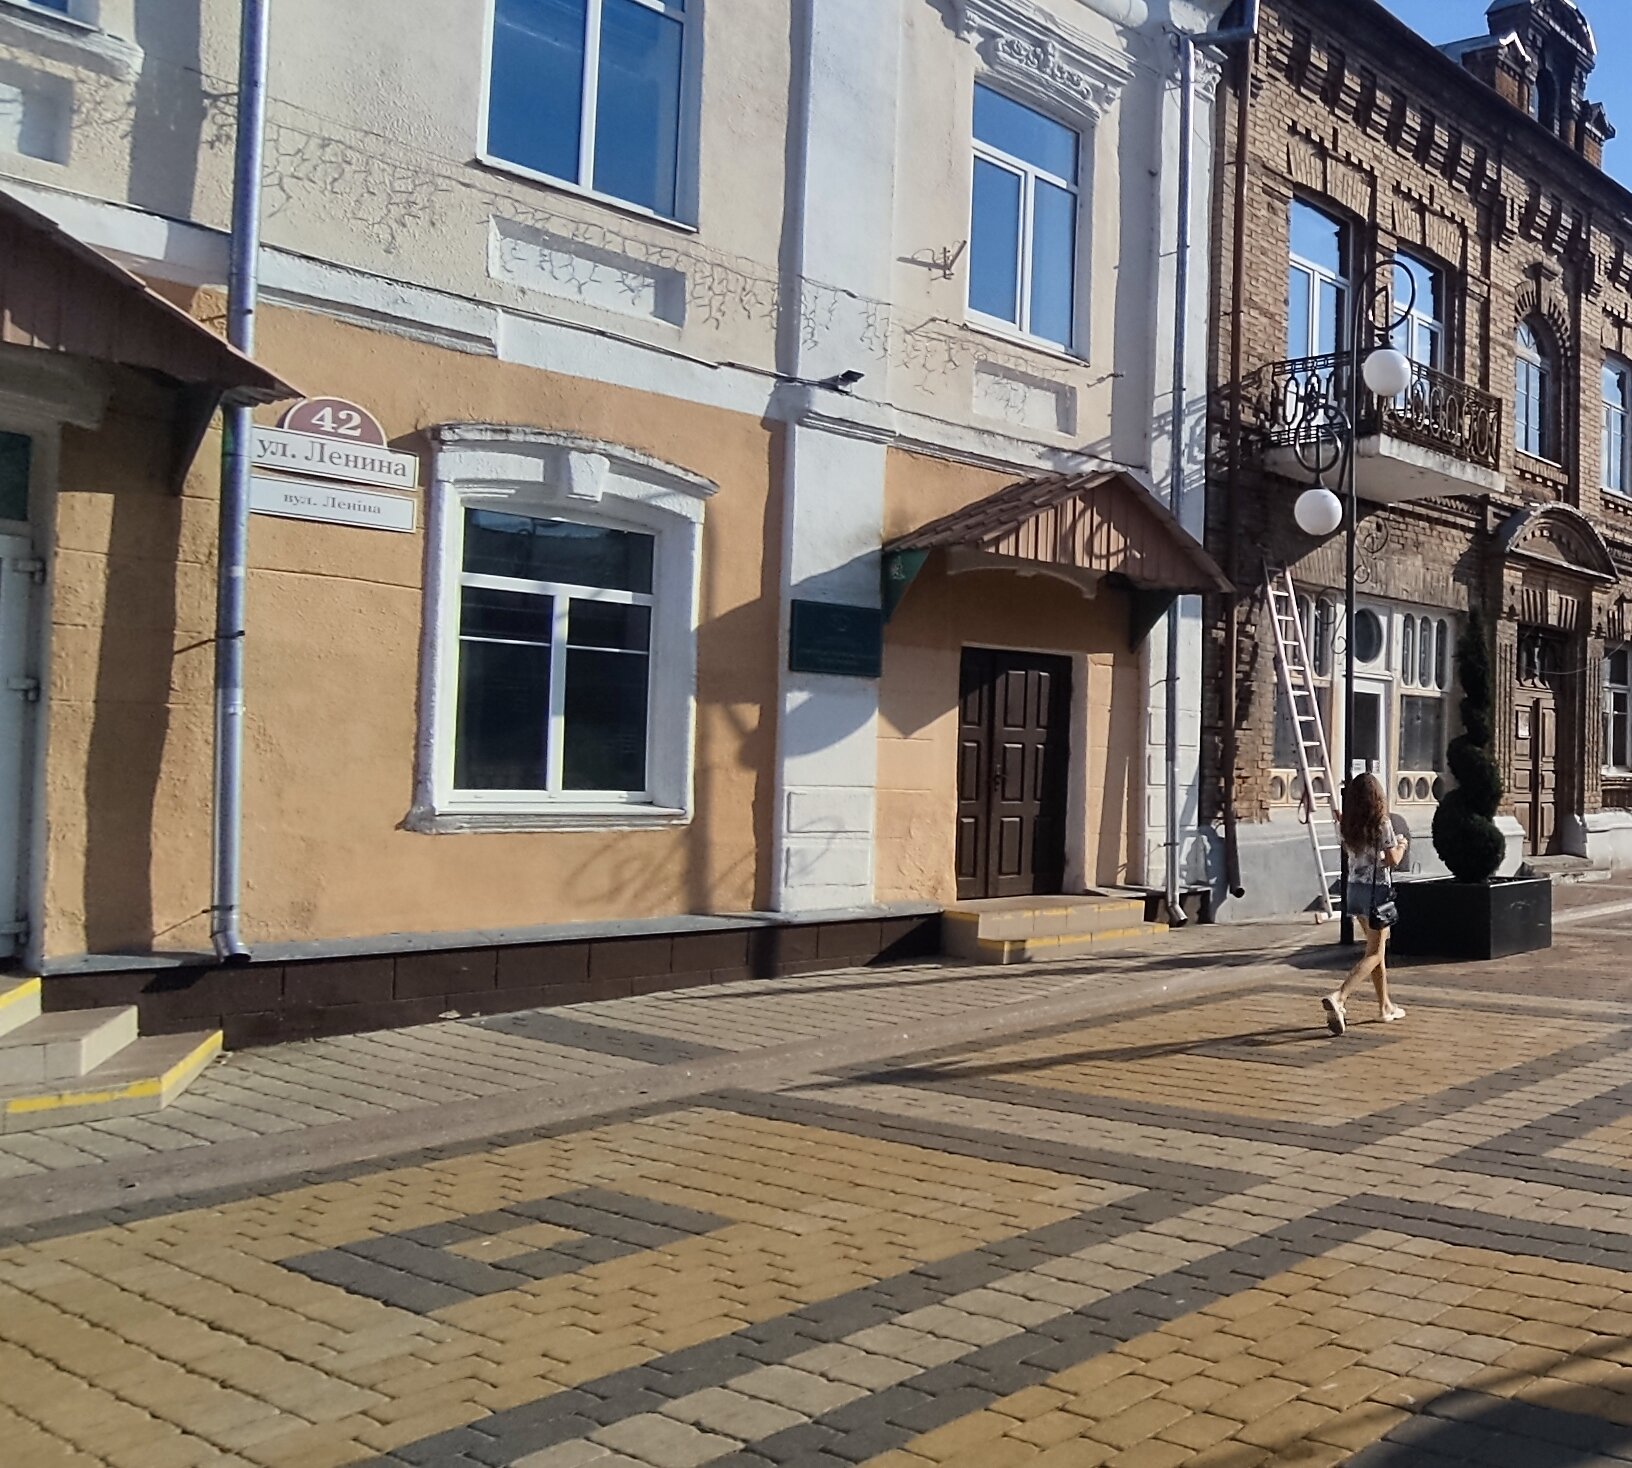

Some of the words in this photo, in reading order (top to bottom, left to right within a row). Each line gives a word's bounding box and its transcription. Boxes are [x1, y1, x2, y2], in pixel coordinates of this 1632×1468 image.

[311, 406, 362, 437] 42
[256, 438, 297, 459] ул.
[304, 440, 406, 477] Ленина
[284, 493, 317, 506] вул.
[322, 496, 381, 514] Леніна
